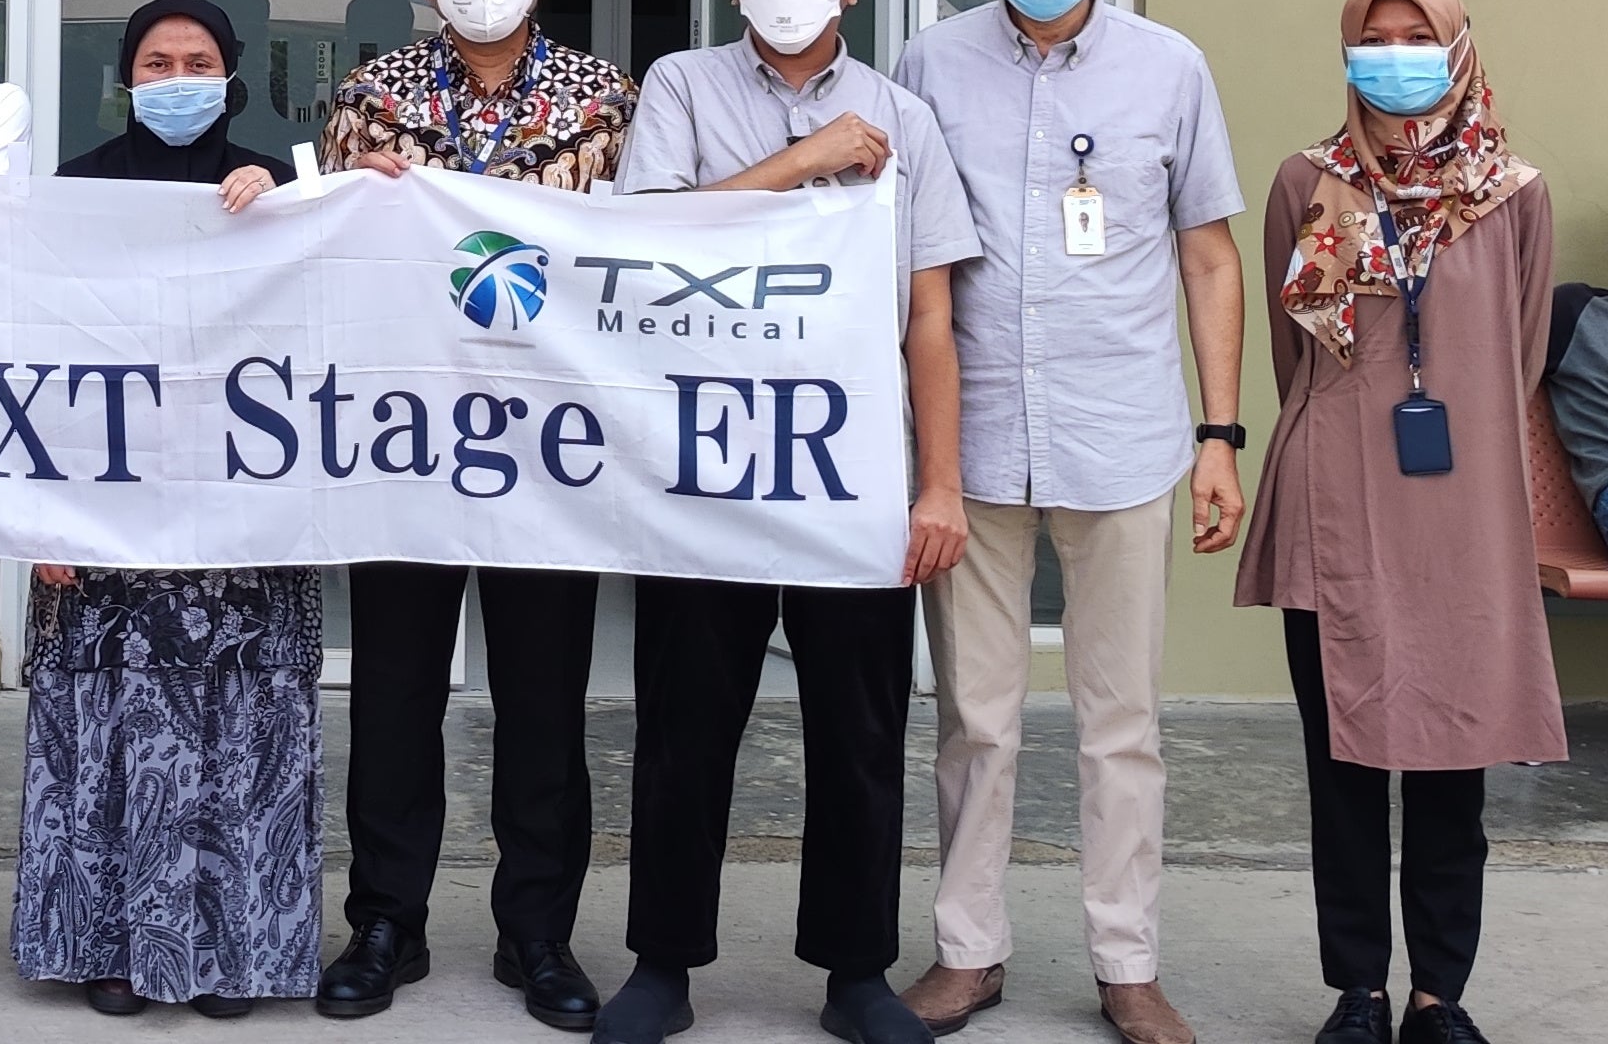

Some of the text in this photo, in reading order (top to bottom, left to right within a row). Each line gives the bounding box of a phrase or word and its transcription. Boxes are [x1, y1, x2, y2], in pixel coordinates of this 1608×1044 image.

[574, 256, 833, 310] TXP
[597, 309, 805, 340] Medical
[225, 355, 605, 498] Stage
[665, 374, 859, 501] ER
